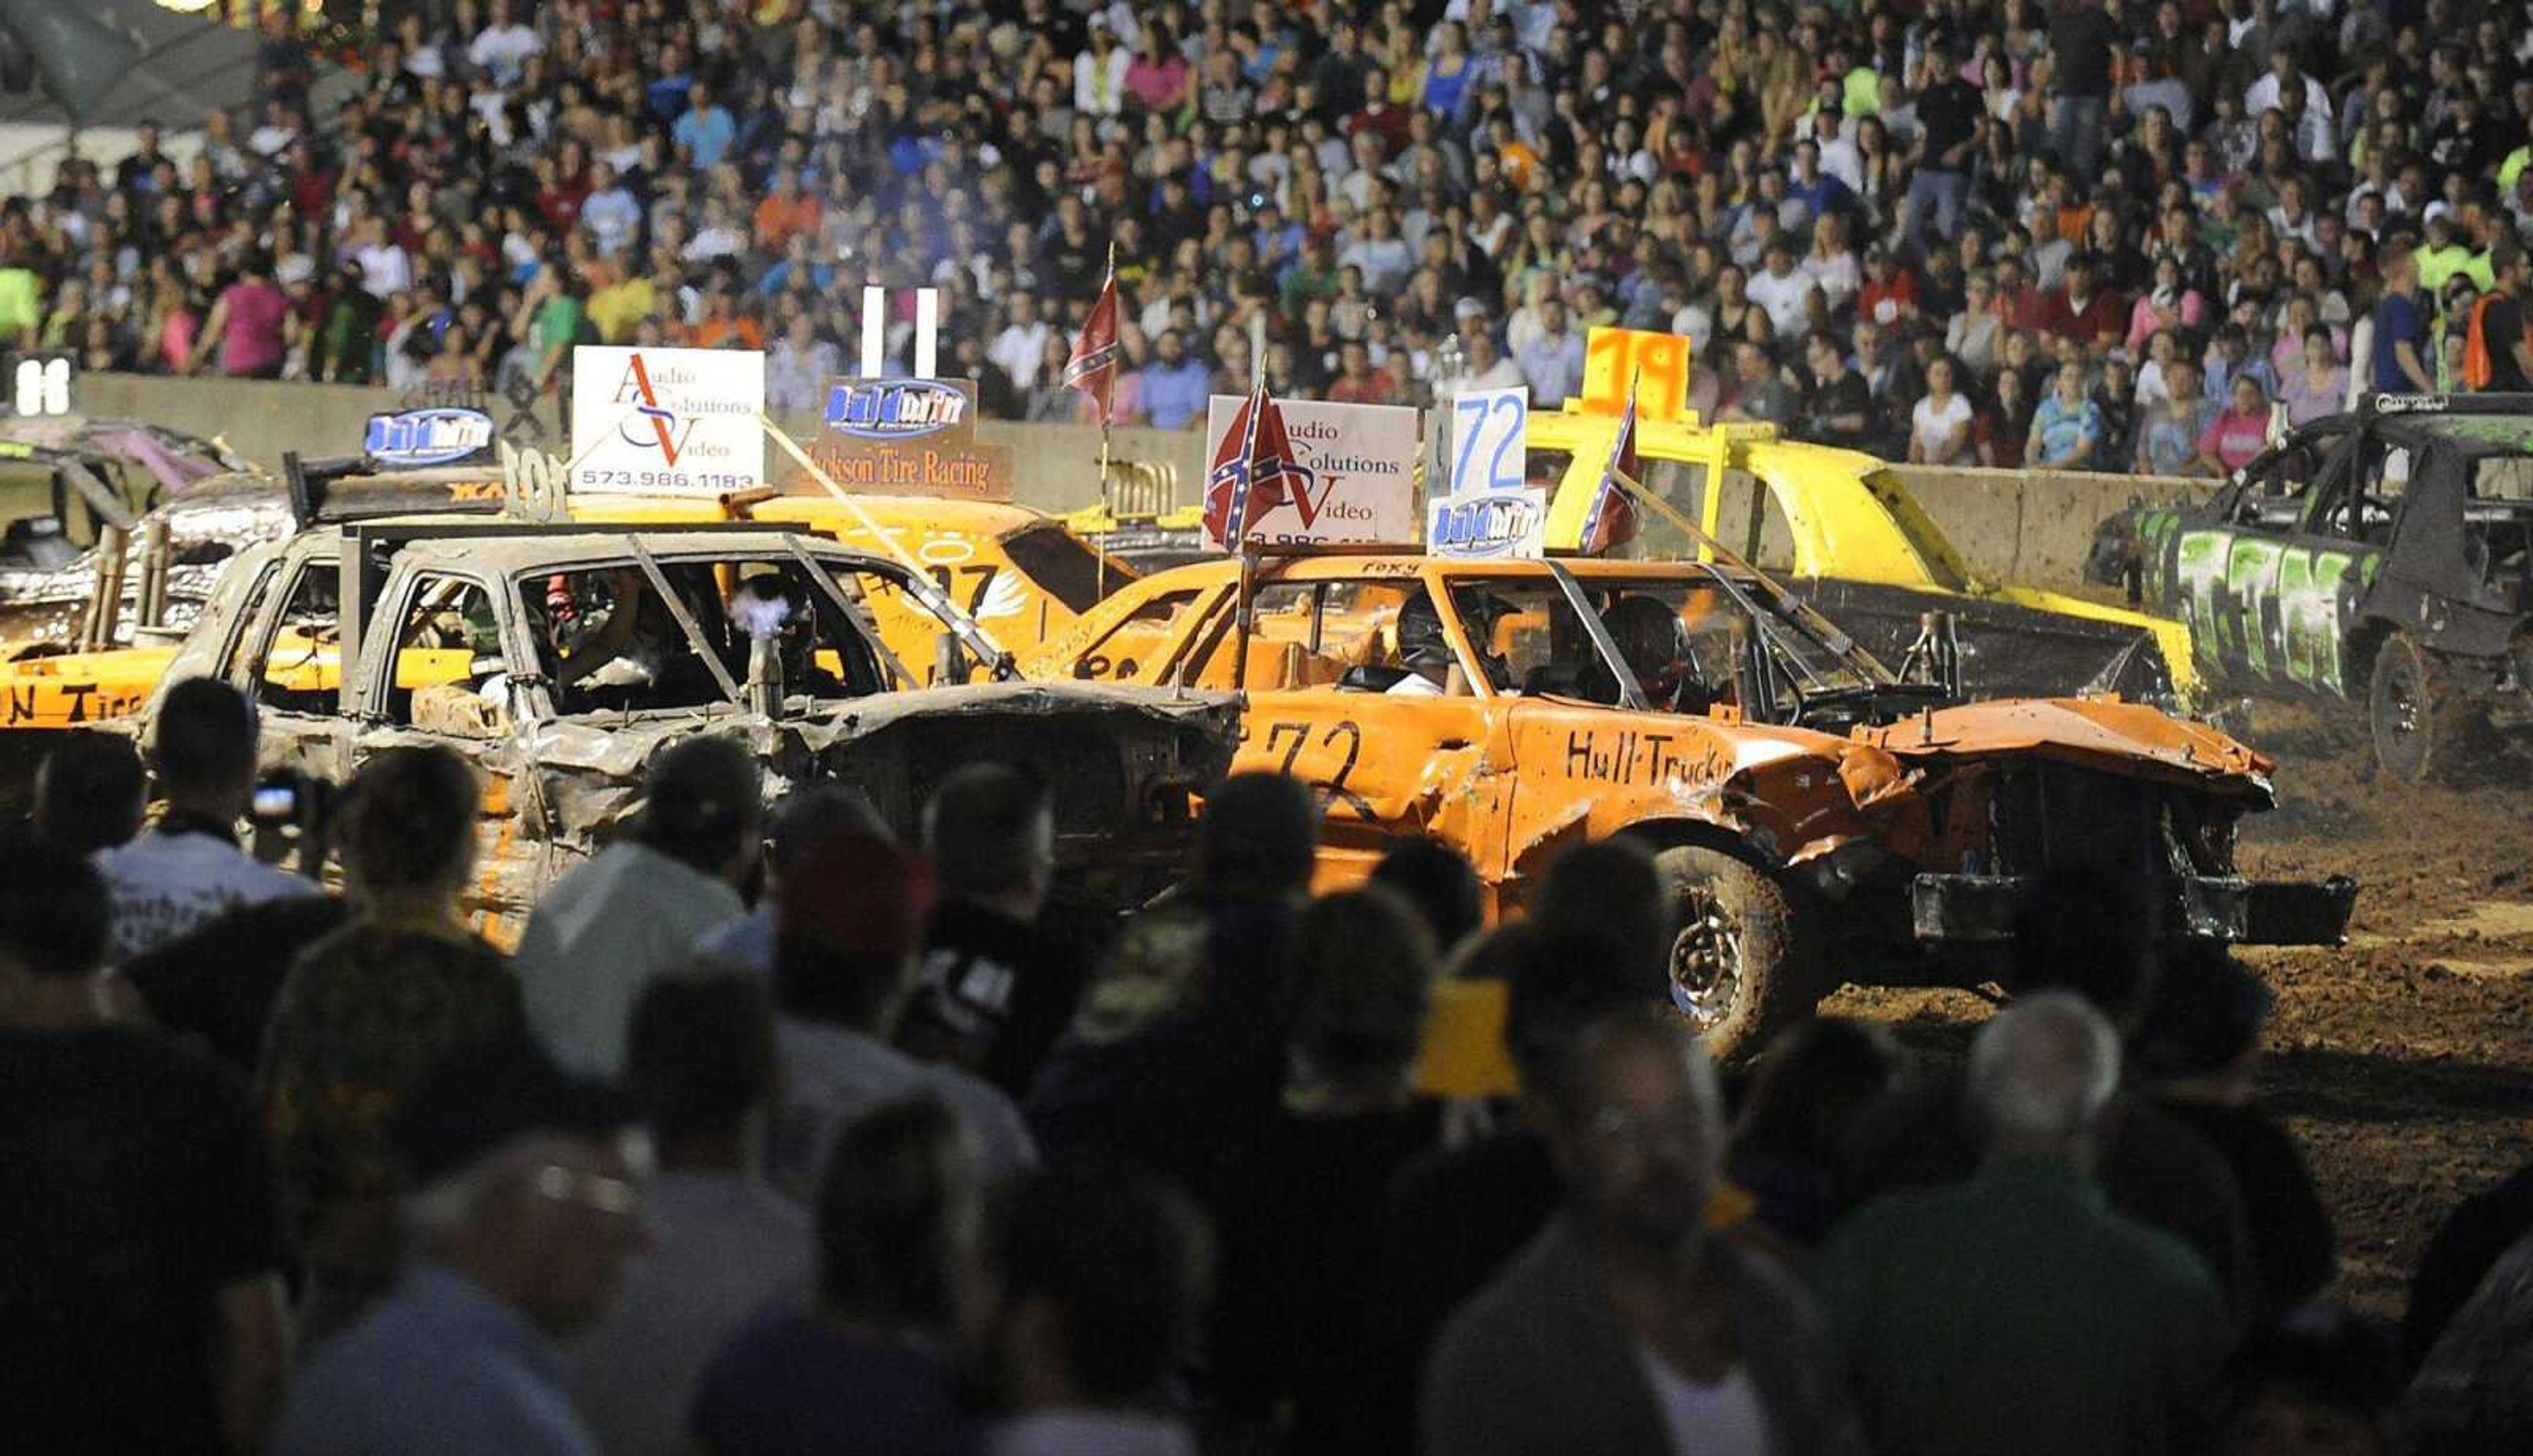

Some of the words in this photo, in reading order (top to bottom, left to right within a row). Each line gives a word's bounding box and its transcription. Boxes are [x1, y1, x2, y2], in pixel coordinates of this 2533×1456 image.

[880, 448, 918, 483] Tire
[924, 451, 989, 493] Racing
[1453, 394, 1524, 491] 72
[582, 470, 754, 489] 573.986.1183
[1266, 720, 1379, 824] 72
